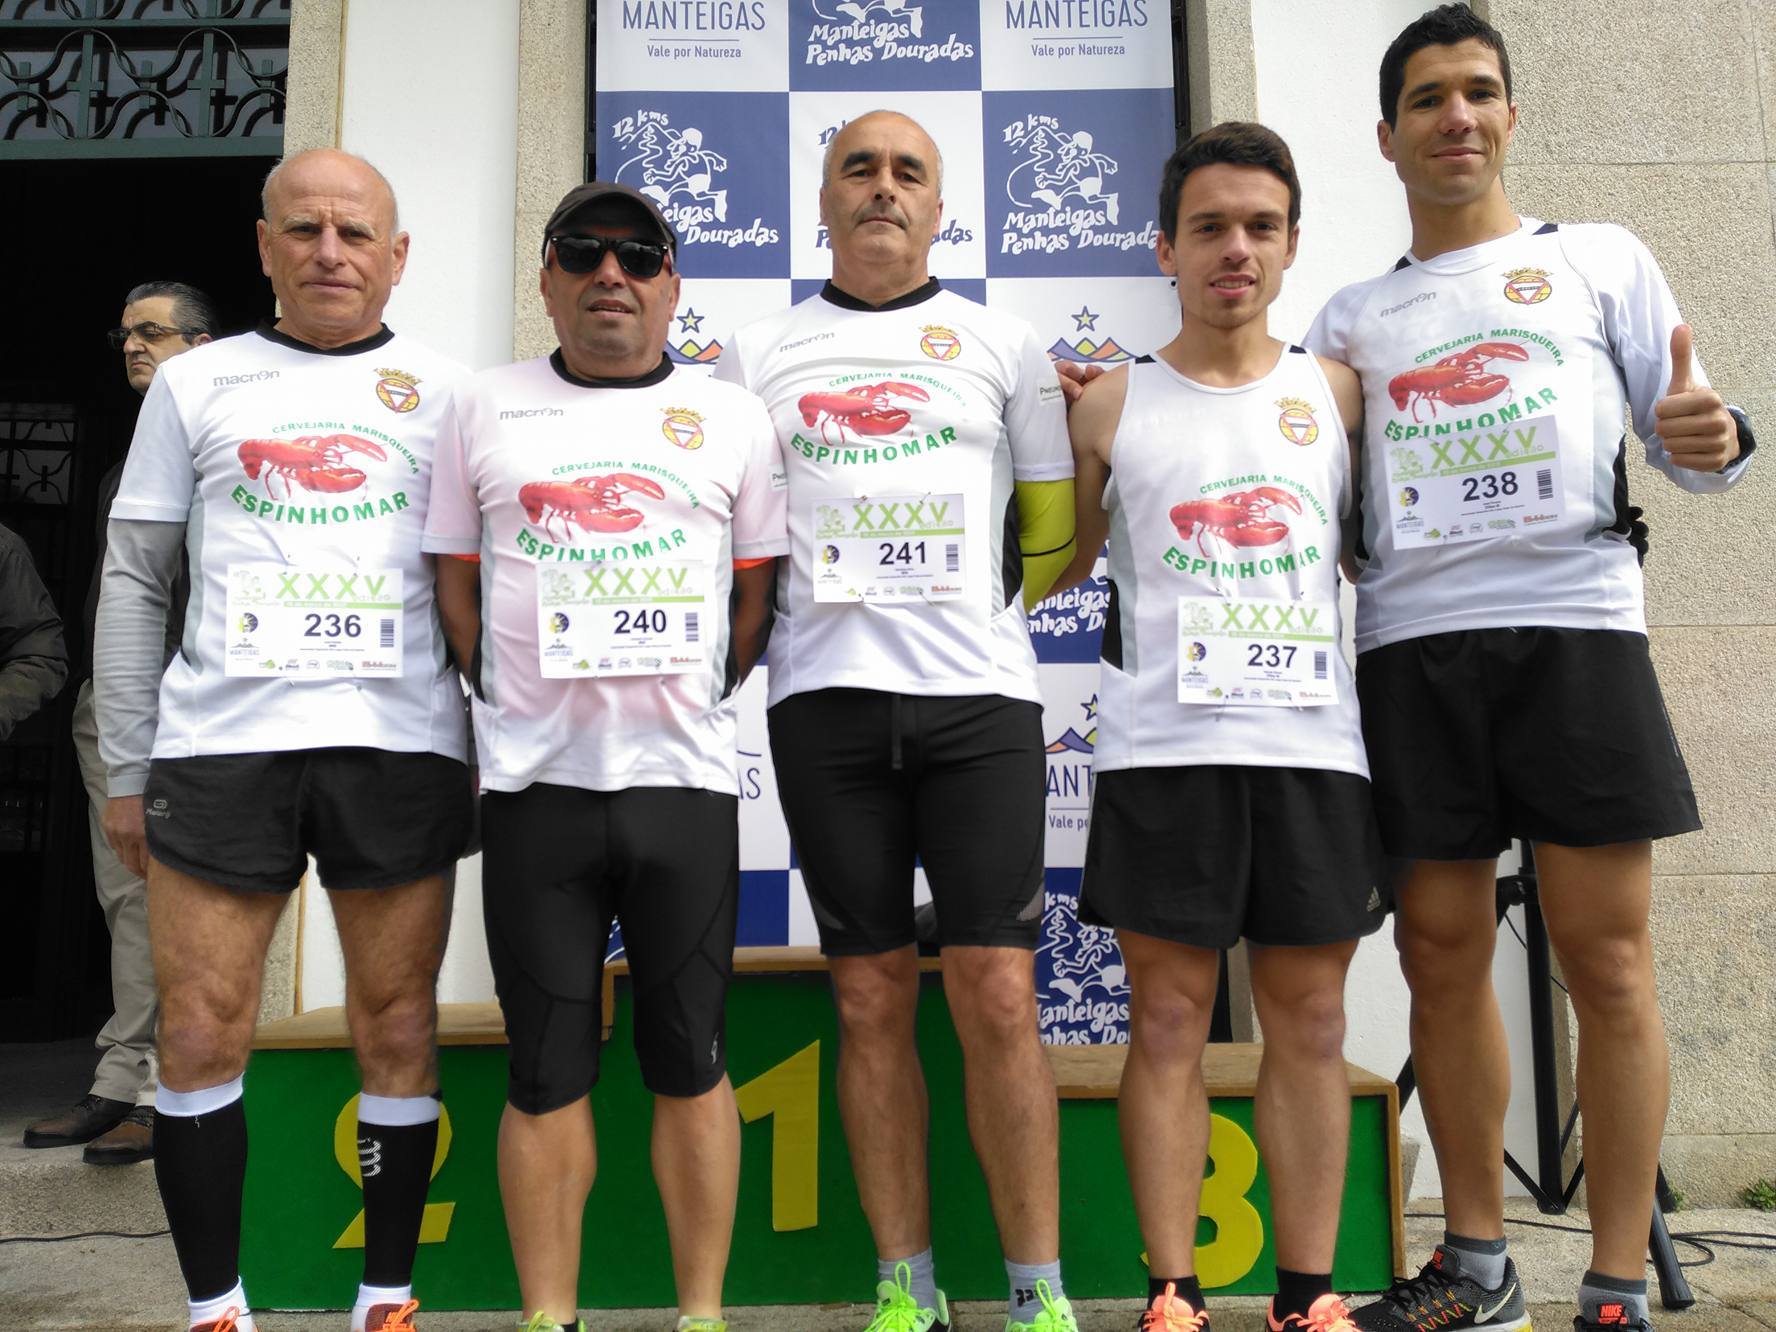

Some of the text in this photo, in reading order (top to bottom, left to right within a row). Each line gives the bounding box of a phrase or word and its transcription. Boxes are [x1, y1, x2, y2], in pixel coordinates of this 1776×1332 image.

[622, 1, 766, 31] MANTEIGAS
[1006, 0, 1148, 29] MANTEIGAS
[808, 19, 910, 48] Manteigas
[647, 45, 742, 60] Vale por Natureza
[805, 33, 975, 66] Penhas Douradas
[1031, 43, 1126, 59] Vale por Natureza
[612, 109, 669, 138] 12 kms
[1002, 113, 1059, 142] 12 kms
[656, 201, 714, 233] eigas
[1002, 206, 1106, 236] Manteigas
[683, 217, 780, 248] Douradas
[1001, 231, 1070, 255] Penhas
[1077, 220, 1161, 251] Dourada
[1415, 328, 1565, 367] CERVEJARIA MARISQUEIRA
[213, 370, 280, 387] macron
[829, 372, 893, 387] CERVEJARIA
[1384, 387, 1558, 442] ESPINHOMAR
[272, 421, 419, 475] CERVEJARIA MARISQUEIRA
[790, 425, 959, 465] ESPINHOMAR
[552, 460, 624, 476] CERVEJARIA
[1199, 474, 1267, 495] CERVEJARIA
[1462, 471, 1519, 502] 238
[231, 484, 410, 525] ESPINHOMAR
[515, 527, 687, 562] ESPINHOMAR
[879, 541, 926, 566] 241
[303, 613, 362, 638] 236
[613, 609, 667, 635] 240
[1027, 612, 1078, 637] nhas
[1247, 643, 1298, 669] 237
[1048, 814, 1073, 829] Vale
[1044, 891, 1079, 912] kms
[1036, 998, 1131, 1033] anteigas
[734, 1039, 820, 1232] 1
[1600, 1303, 1622, 1318] NIKE
